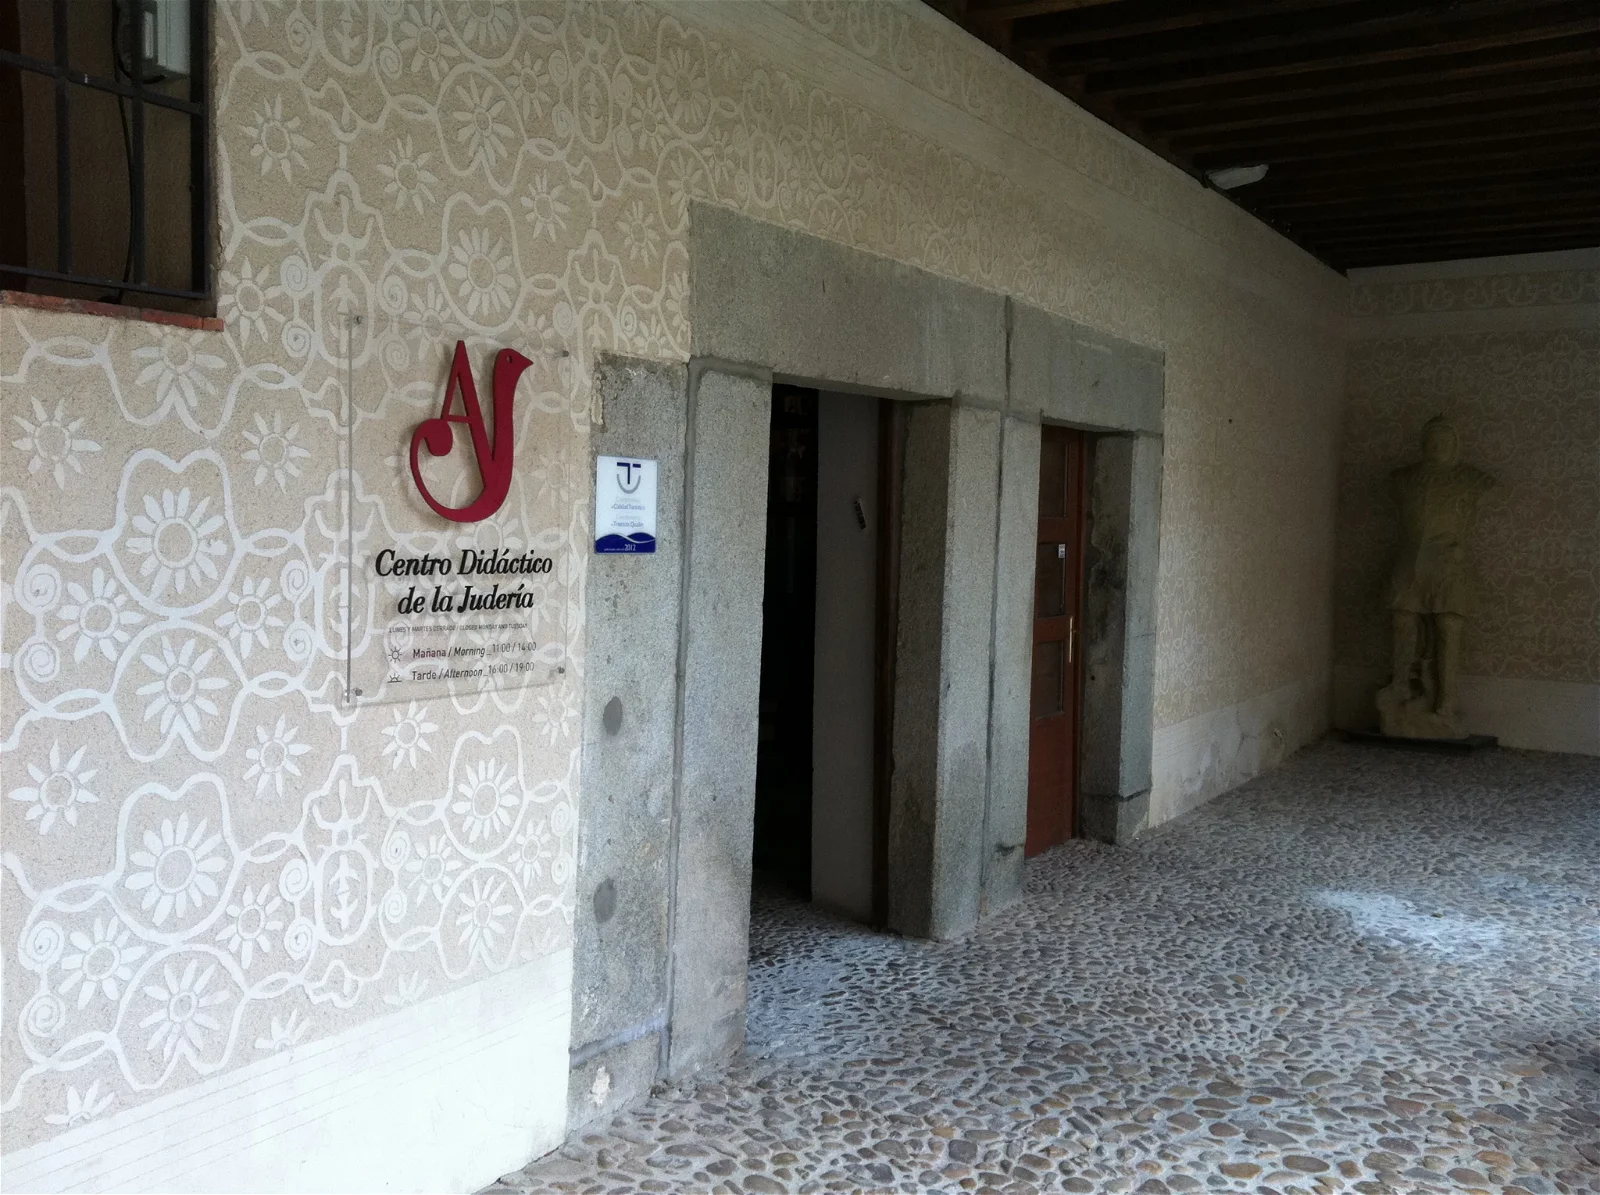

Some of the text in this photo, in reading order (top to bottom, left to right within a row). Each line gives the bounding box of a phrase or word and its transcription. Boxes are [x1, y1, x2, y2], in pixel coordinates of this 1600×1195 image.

[624, 543, 637, 552] 2012
[375, 548, 553, 576] Centro Didáctico
[397, 583, 534, 614] de la Judería
[412, 648, 447, 659] Mañana
[453, 646, 486, 658] Morning
[411, 670, 437, 681] Tarde
[443, 668, 483, 679] Afternoon
